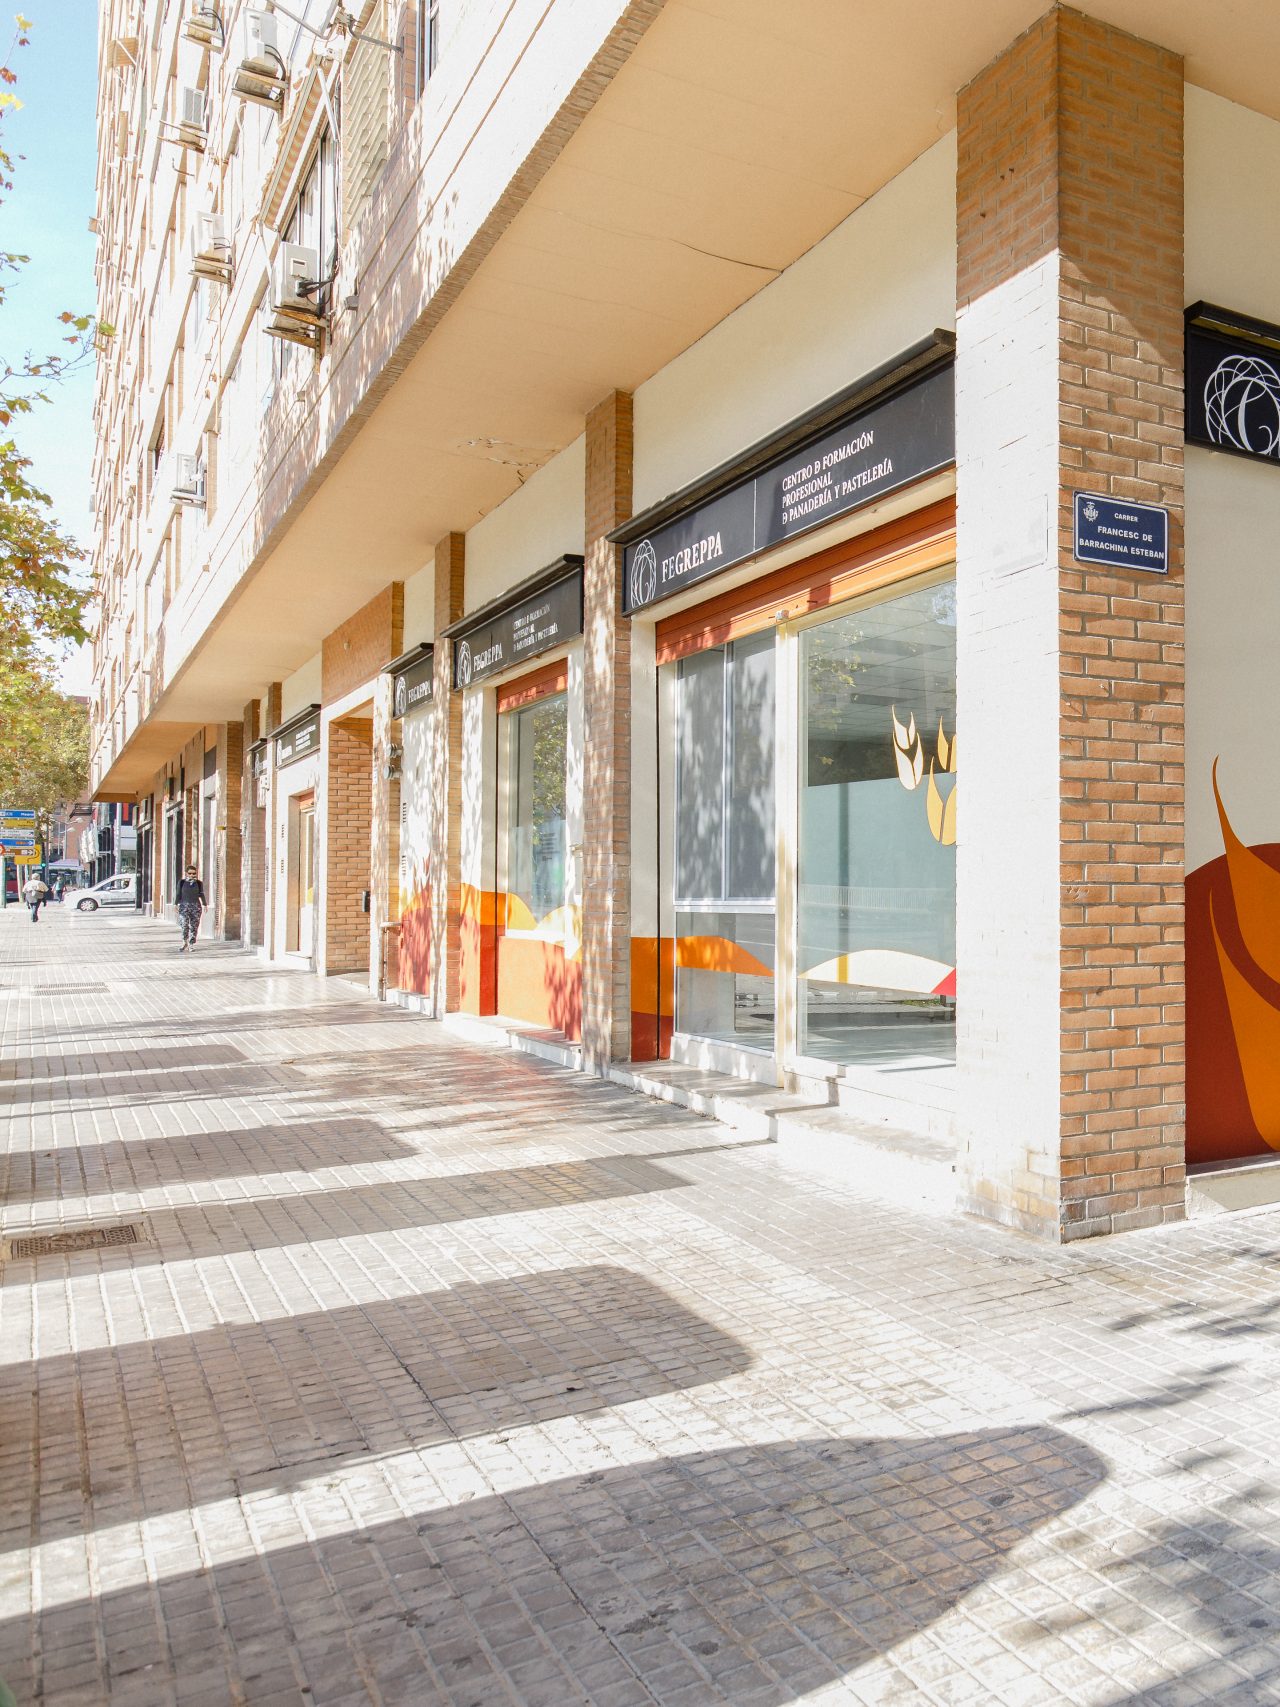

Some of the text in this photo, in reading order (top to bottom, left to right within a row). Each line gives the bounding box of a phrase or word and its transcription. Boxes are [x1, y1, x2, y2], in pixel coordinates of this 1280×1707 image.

[782, 465, 813, 491] CENTRO
[822, 430, 874, 470] FORMACIÓN
[782, 472, 833, 508] PROFESIONAL
[789, 488, 832, 522] PANADERÍA
[834, 485, 840, 499] Y
[842, 457, 893, 496] PASTELERÍA
[1097, 525, 1153, 542] FRANCESC DE
[1114, 513, 1138, 522] CARRER
[661, 531, 723, 583] FEGREPPA
[1079, 538, 1164, 559] BARRACHINA ESTEBAN
